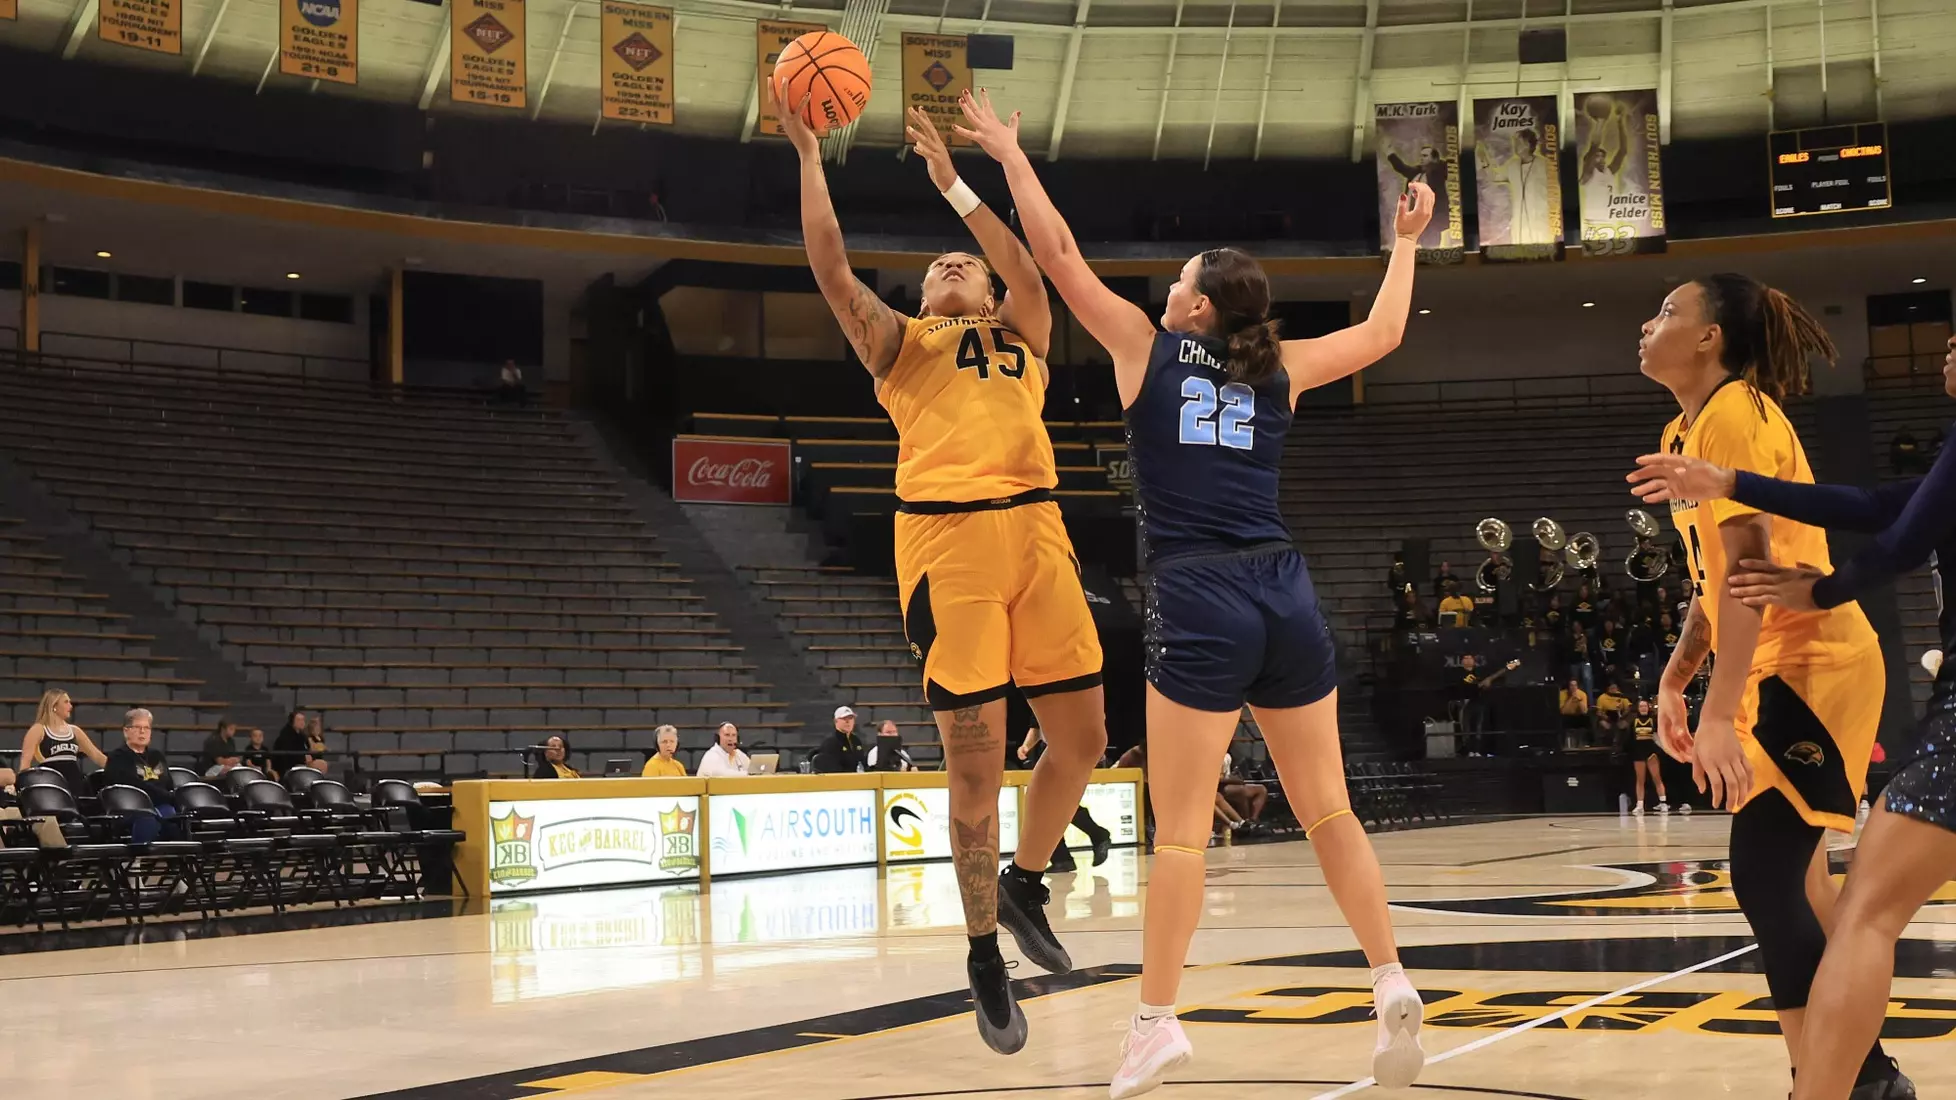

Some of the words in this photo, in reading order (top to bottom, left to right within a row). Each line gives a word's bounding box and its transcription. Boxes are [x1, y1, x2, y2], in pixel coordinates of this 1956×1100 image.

[302, 2, 340, 19] NCAA
[605, 5, 670, 20] SOUTHERN
[623, 18, 653, 29] MISS
[761, 25, 809, 34] SOUTHE
[292, 25, 348, 41] GOLDEN
[294, 35, 346, 49] EAGLES
[283, 51, 355, 68] TOURNAMENT
[625, 47, 653, 58] NIT
[924, 49, 952, 59] MISS
[462, 54, 516, 68] GOLDEN
[464, 63, 514, 75] EAGLES
[612, 72, 664, 84] GOLDEN
[455, 79, 523, 92] TOURNAMENT
[614, 81, 663, 91] EAGLES
[605, 96, 671, 108] TOURNAMENT
[618, 106, 659, 119] 22-11
[1377, 105, 1405, 117] M.K.
[1409, 104, 1437, 116] Turk
[1501, 103, 1527, 117] Kay
[1493, 116, 1534, 130] James
[1645, 114, 1661, 189] SOUTHERN
[1607, 194, 1646, 207] Janice
[1609, 208, 1648, 219] Felder
[1649, 194, 1664, 229] MISS
[1448, 205, 1462, 240] MISS
[956, 327, 1026, 380] 45
[1179, 376, 1255, 450] 22
[760, 806, 872, 841] AIRSOUTH
[548, 831, 576, 857] KEG
[594, 827, 647, 852] BARREL
